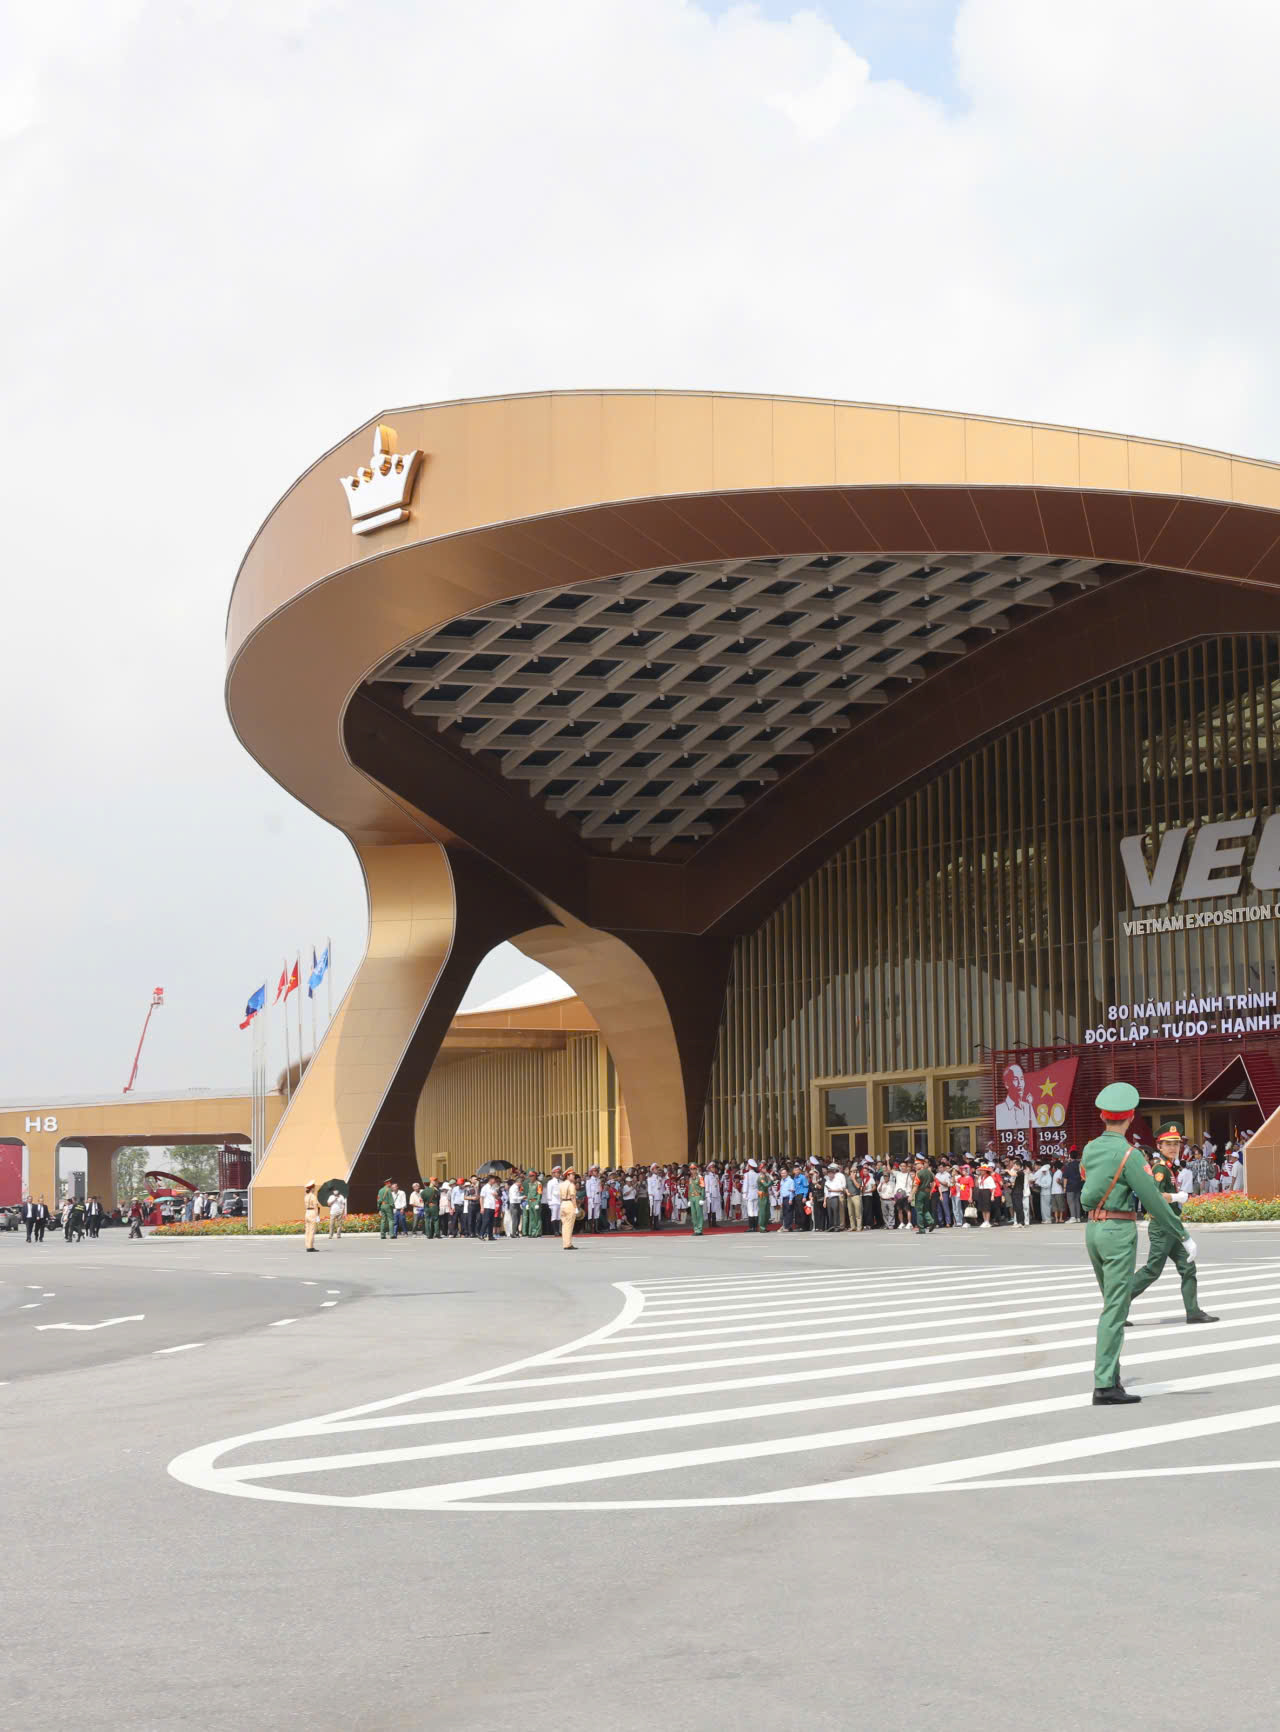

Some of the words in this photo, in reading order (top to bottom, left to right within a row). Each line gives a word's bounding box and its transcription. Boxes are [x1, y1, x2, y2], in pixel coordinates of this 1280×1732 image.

[1123, 915, 1184, 936] VIETNAM
[1186, 904, 1271, 928] EXPOSITION
[1108, 1004, 1129, 1020] 80
[1133, 997, 1171, 1018] NĂM
[1175, 992, 1222, 1015] HÀNH
[1226, 987, 1277, 1010] TRÌNH
[1084, 1023, 1117, 1049] ĐỘC
[1119, 1021, 1150, 1047] LẬP
[1161, 1020, 1184, 1043] TỰ
[1185, 1020, 1208, 1037] DO
[1221, 1014, 1270, 1039] HẠNH
[24, 1116, 59, 1133] H8
[1036, 1103, 1066, 1127] 80
[1040, 1130, 1067, 1141] 1945
[1040, 1144, 1067, 1155] 202
